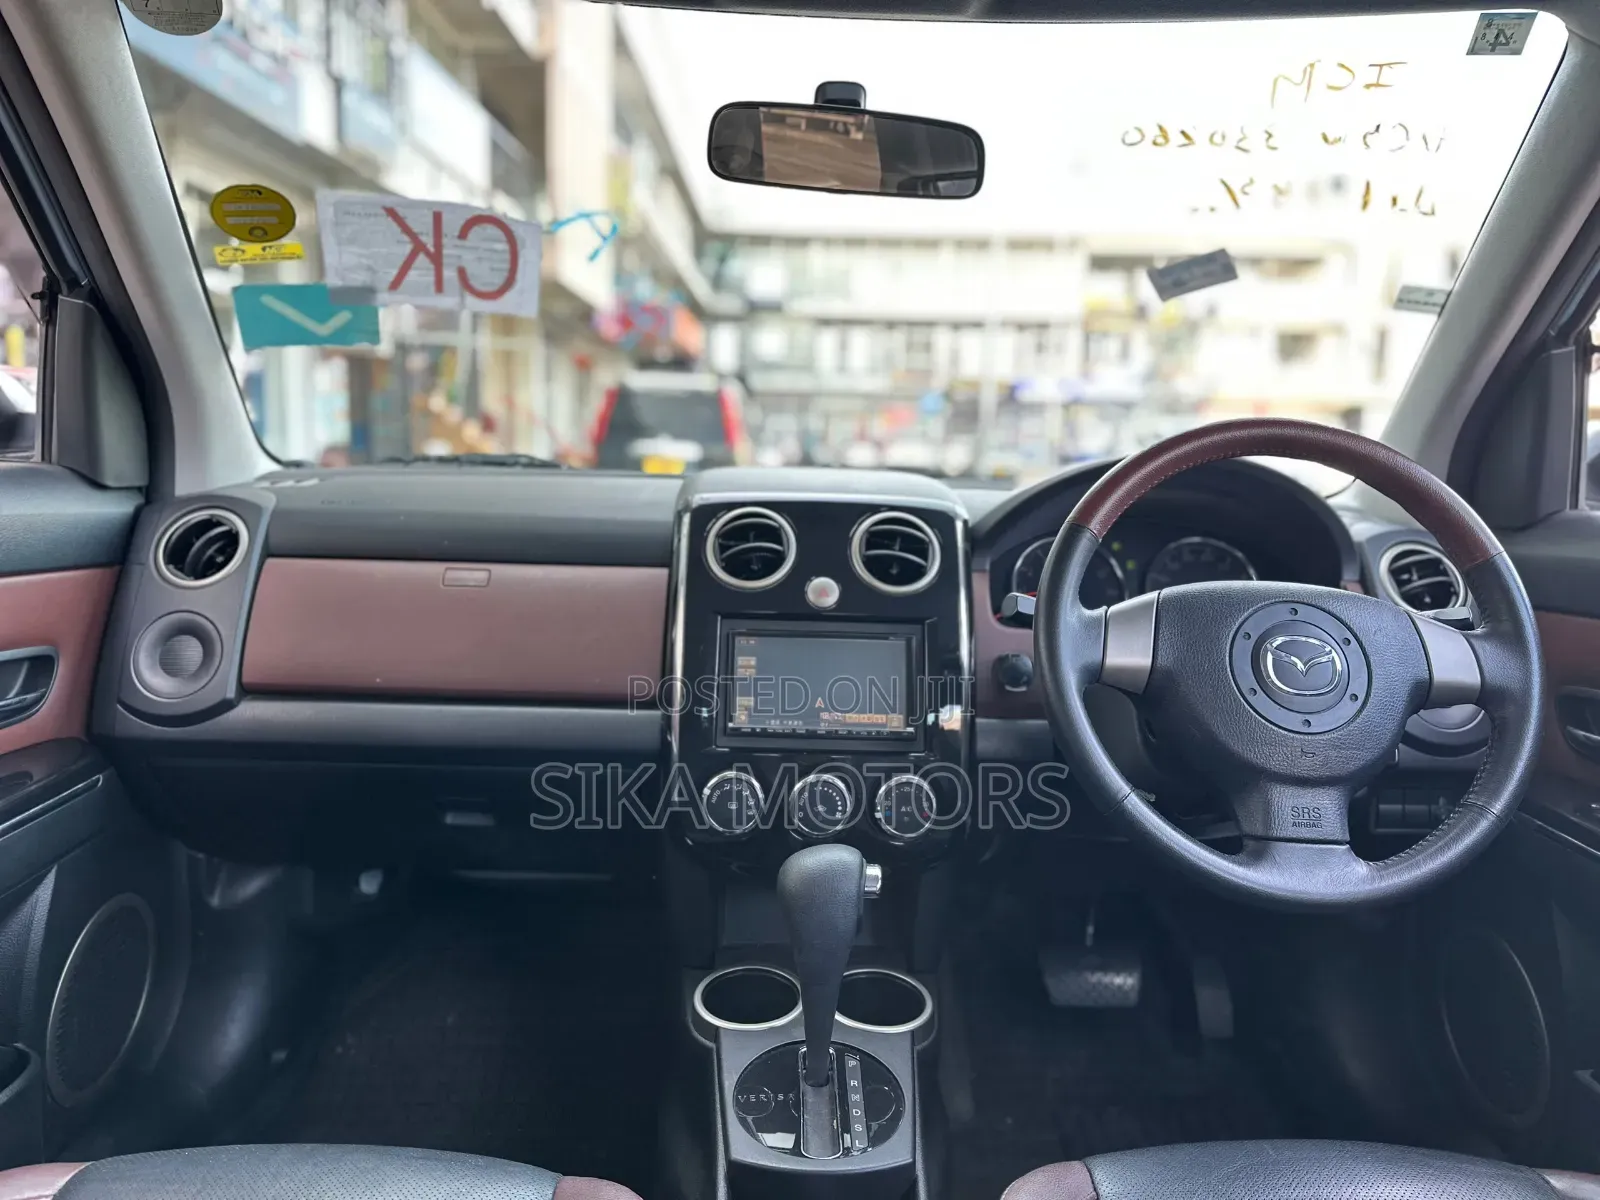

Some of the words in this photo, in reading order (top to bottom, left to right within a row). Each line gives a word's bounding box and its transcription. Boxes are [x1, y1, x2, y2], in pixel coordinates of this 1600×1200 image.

[1290, 806, 1323, 819] SRS
[1291, 821, 1323, 829] AIRBAG
[848, 1060, 857, 1068] P
[738, 1092, 795, 1103] VERISA
[852, 1108, 861, 1116] D
[854, 1124, 863, 1132] S
[855, 1139, 864, 1148] L
